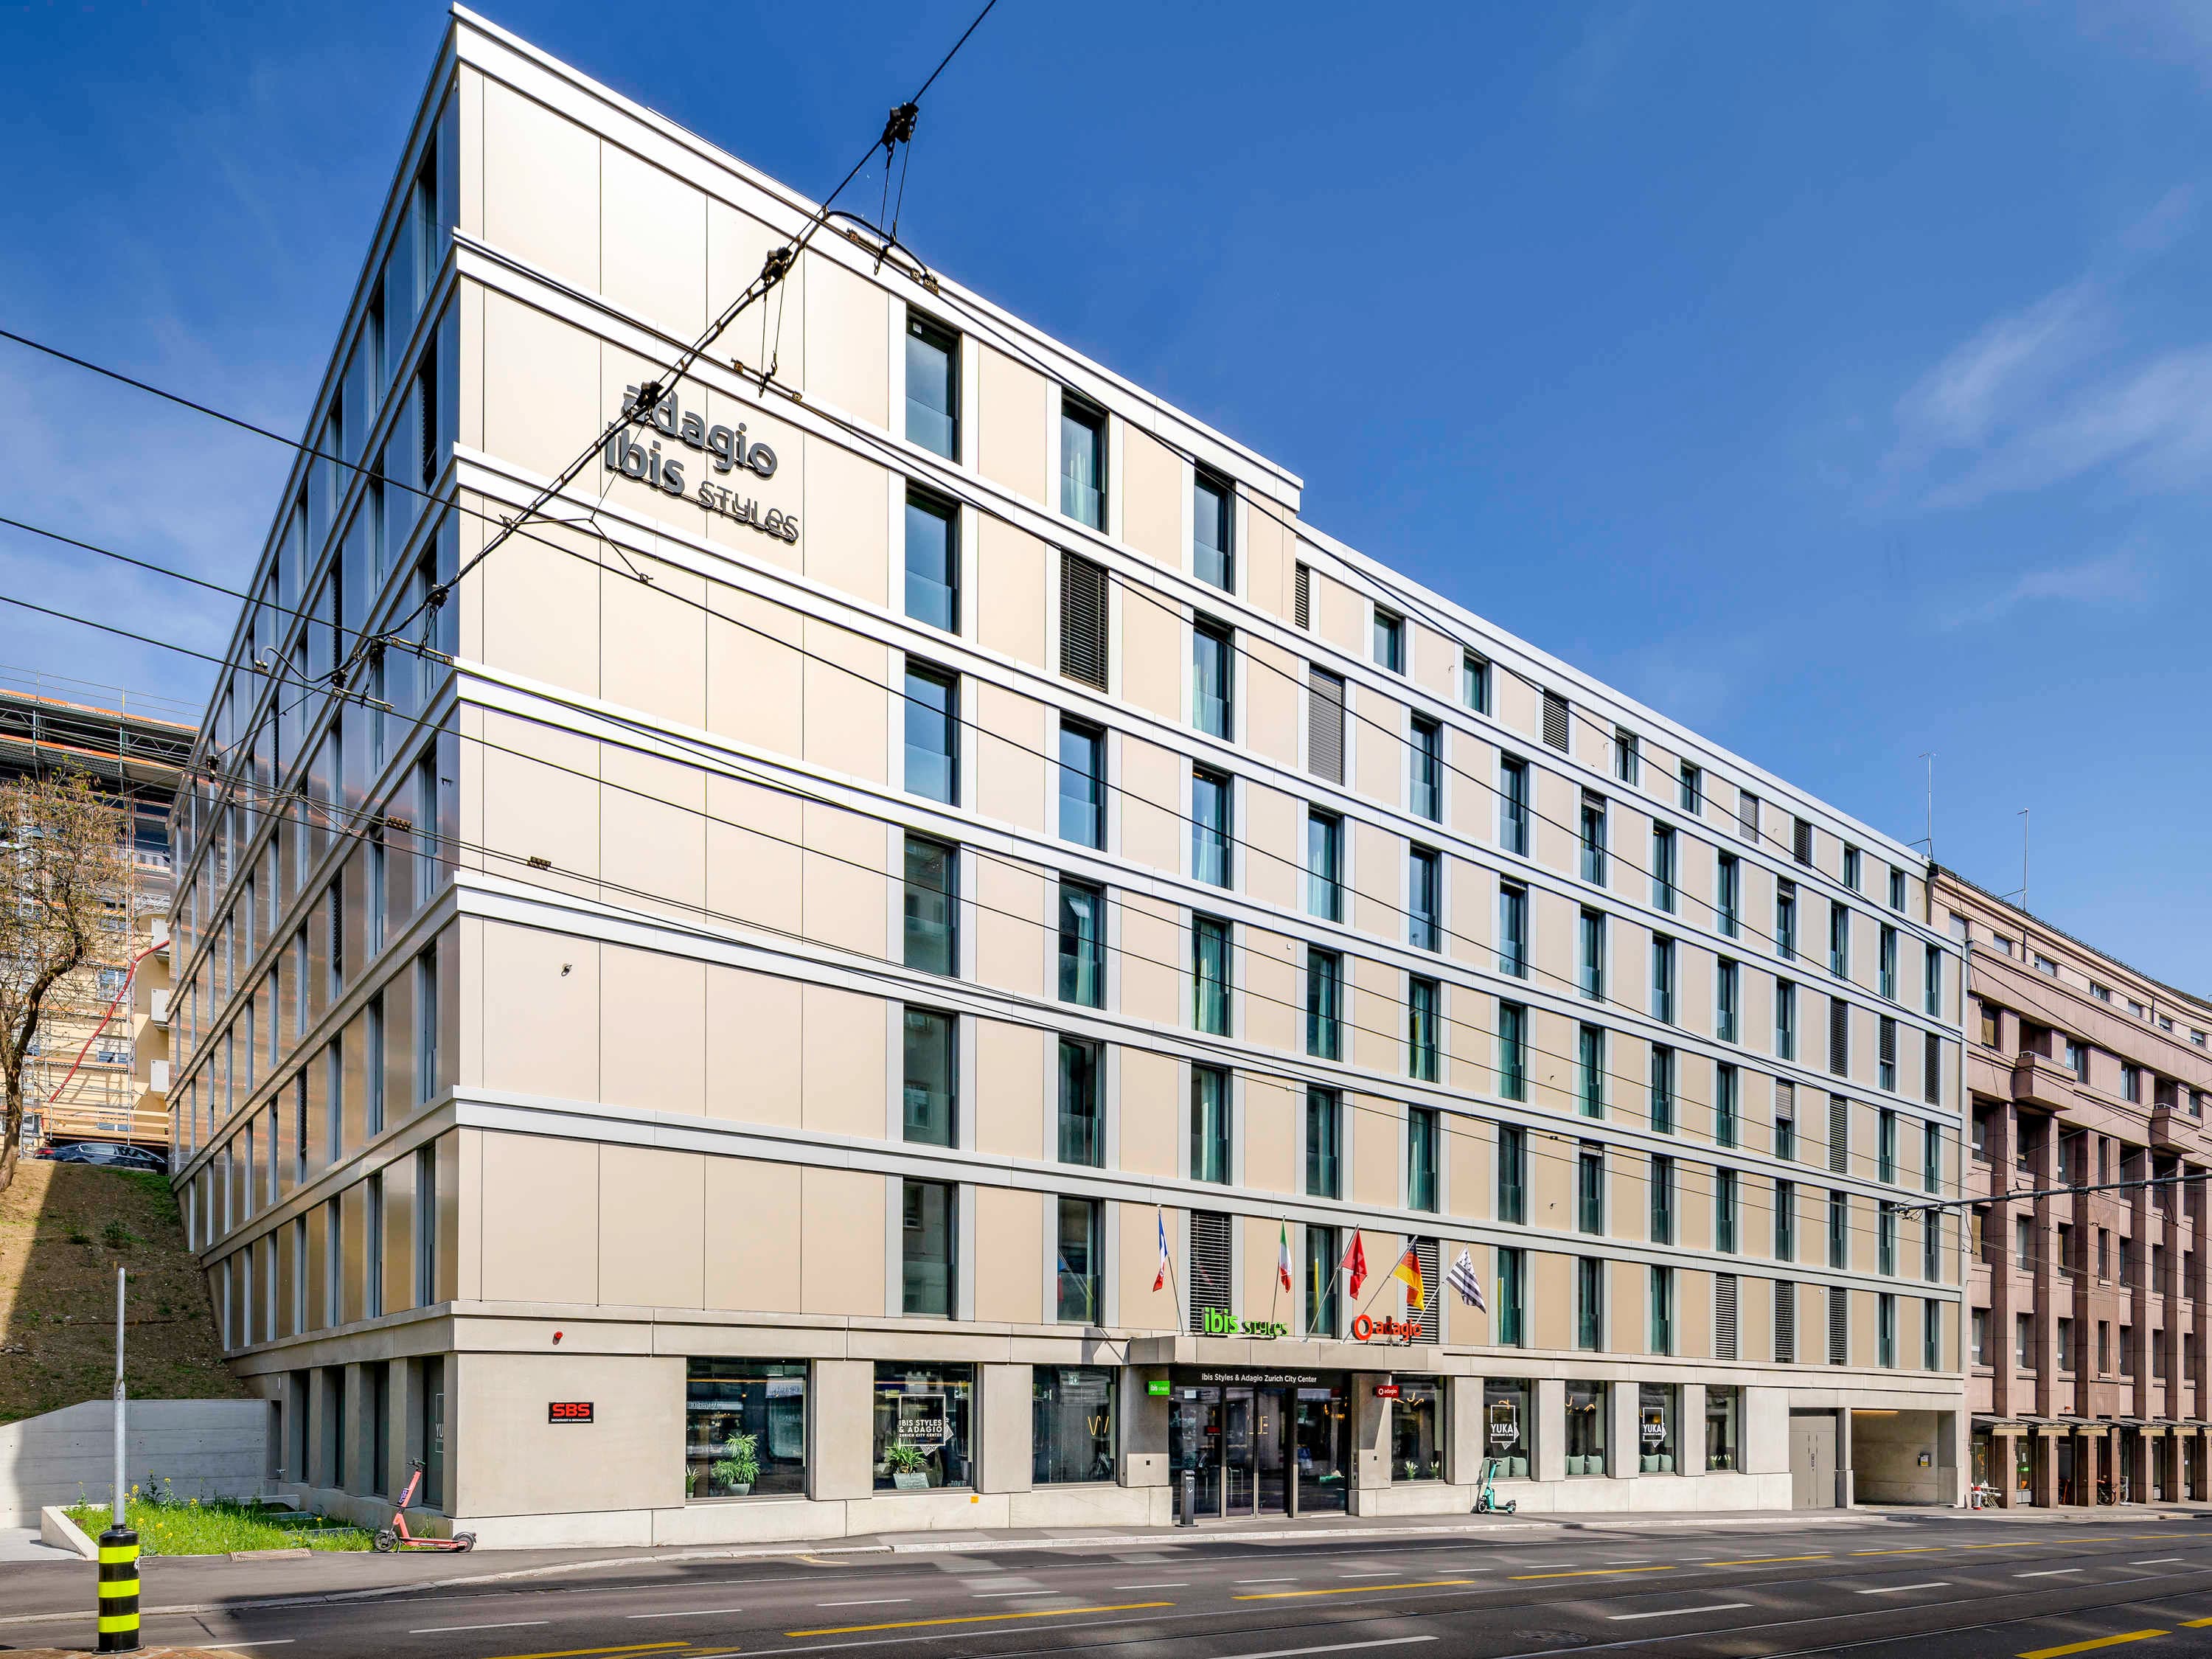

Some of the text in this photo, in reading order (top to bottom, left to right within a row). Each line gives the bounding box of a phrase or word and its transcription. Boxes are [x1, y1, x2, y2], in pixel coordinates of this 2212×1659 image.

[1204, 1307, 1239, 1334] ibis
[1375, 1315, 1422, 1341] adagio
[1214, 1374, 1234, 1382] Styles
[1241, 1374, 1263, 1383] Adagio
[1284, 1375, 1297, 1383] City
[552, 1403, 591, 1417] SBS
[1490, 1423, 1514, 1433] YUKA
[1643, 1424, 1662, 1433] YUKA
